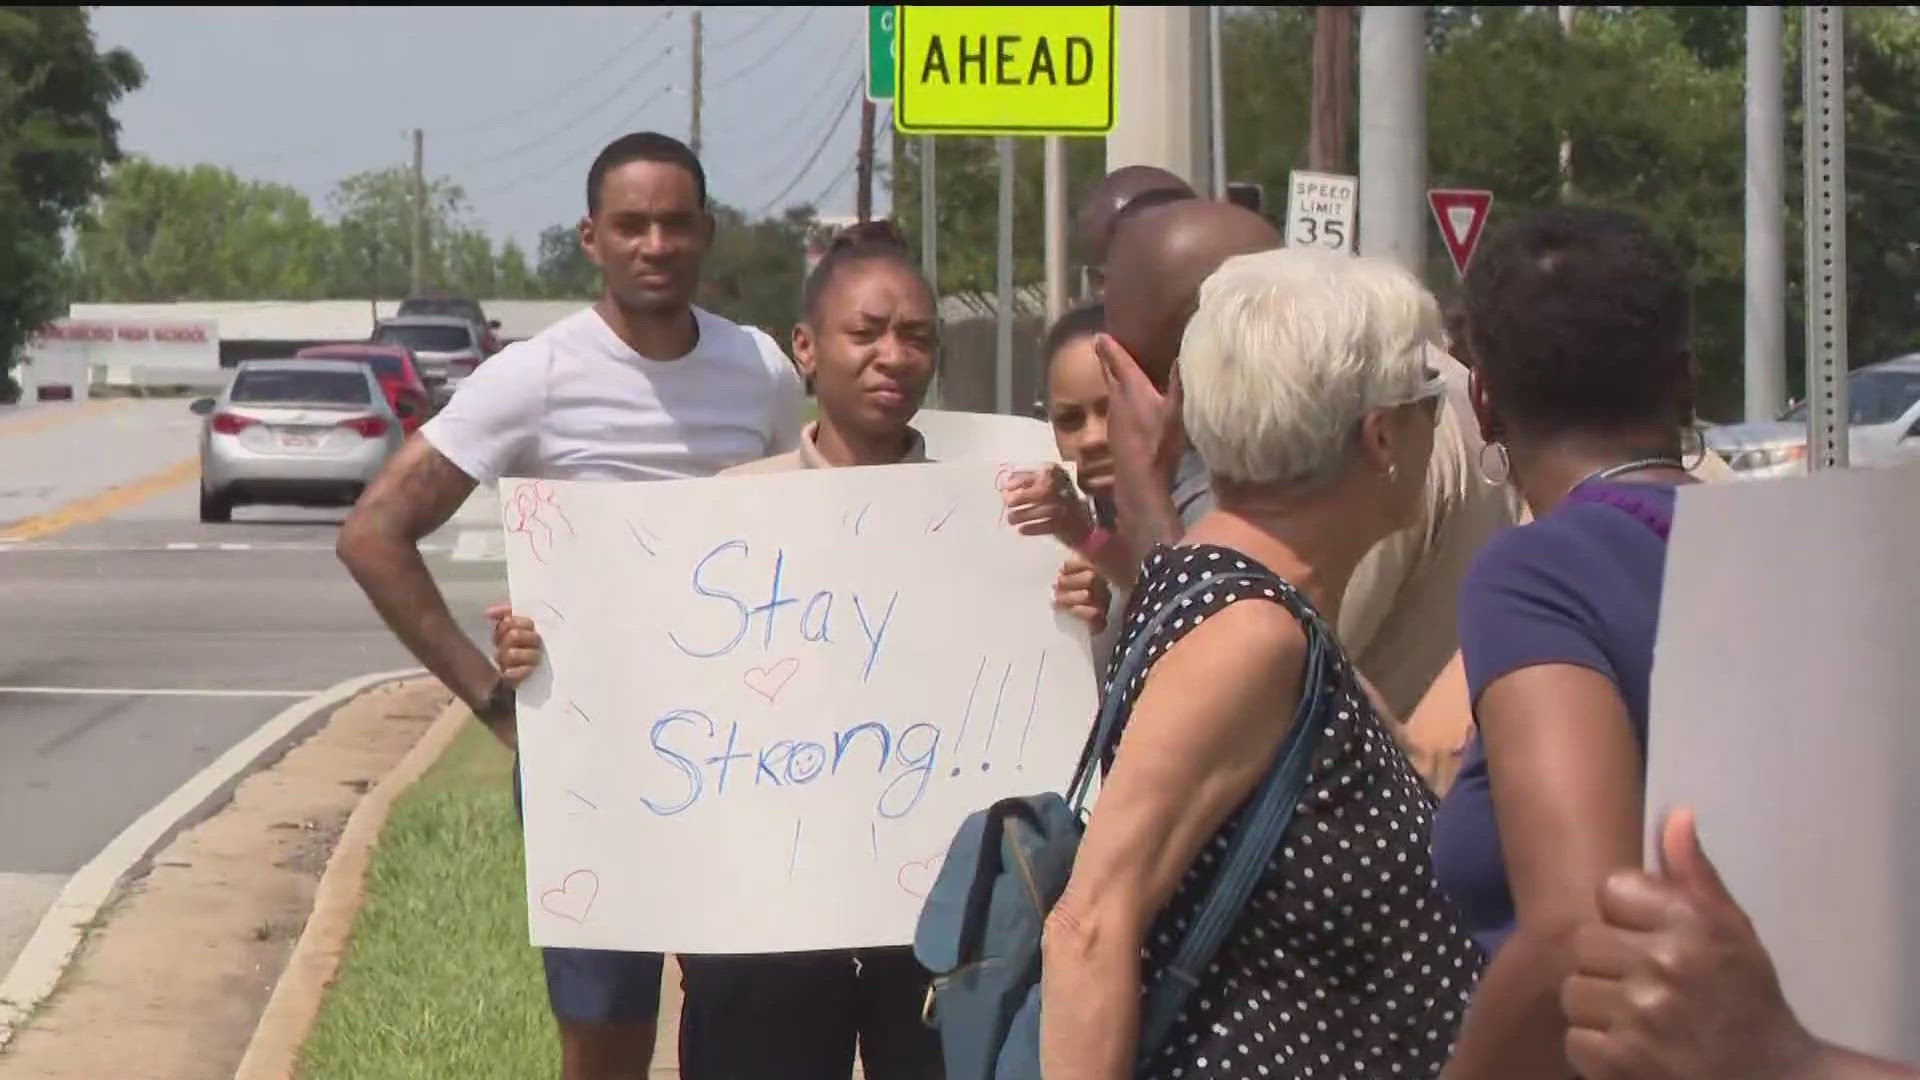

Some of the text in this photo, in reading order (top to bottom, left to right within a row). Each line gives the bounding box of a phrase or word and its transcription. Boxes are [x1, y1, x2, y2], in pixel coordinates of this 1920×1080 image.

[920, 34, 1094, 86] AHEAD
[1296, 182, 1351, 199] SPEED
[1300, 201, 1342, 215] LIMIT
[1296, 217, 1344, 249] 35
[667, 539, 899, 684] Stay
